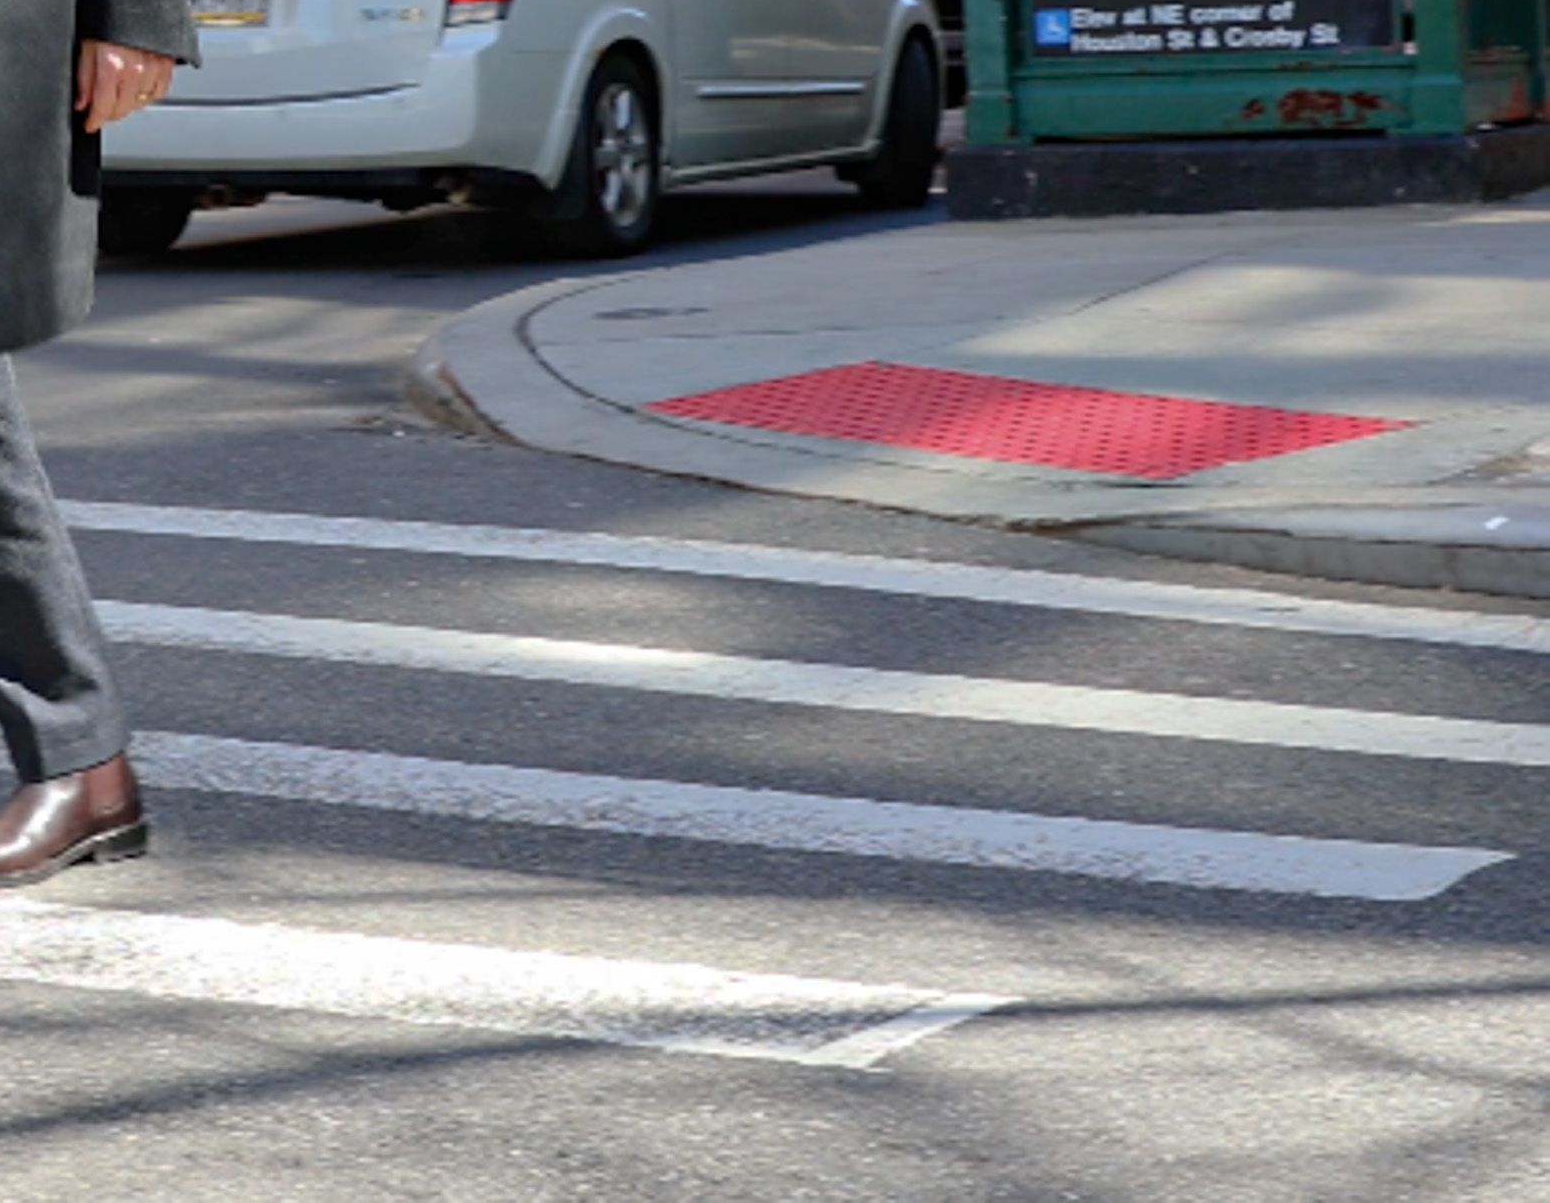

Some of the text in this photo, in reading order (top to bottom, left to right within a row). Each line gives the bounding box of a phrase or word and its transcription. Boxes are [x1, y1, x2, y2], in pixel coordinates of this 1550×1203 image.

[1070, 0, 1295, 28] Elev at NE corner of
[1070, 22, 1340, 52] Houston St & Crosby St
